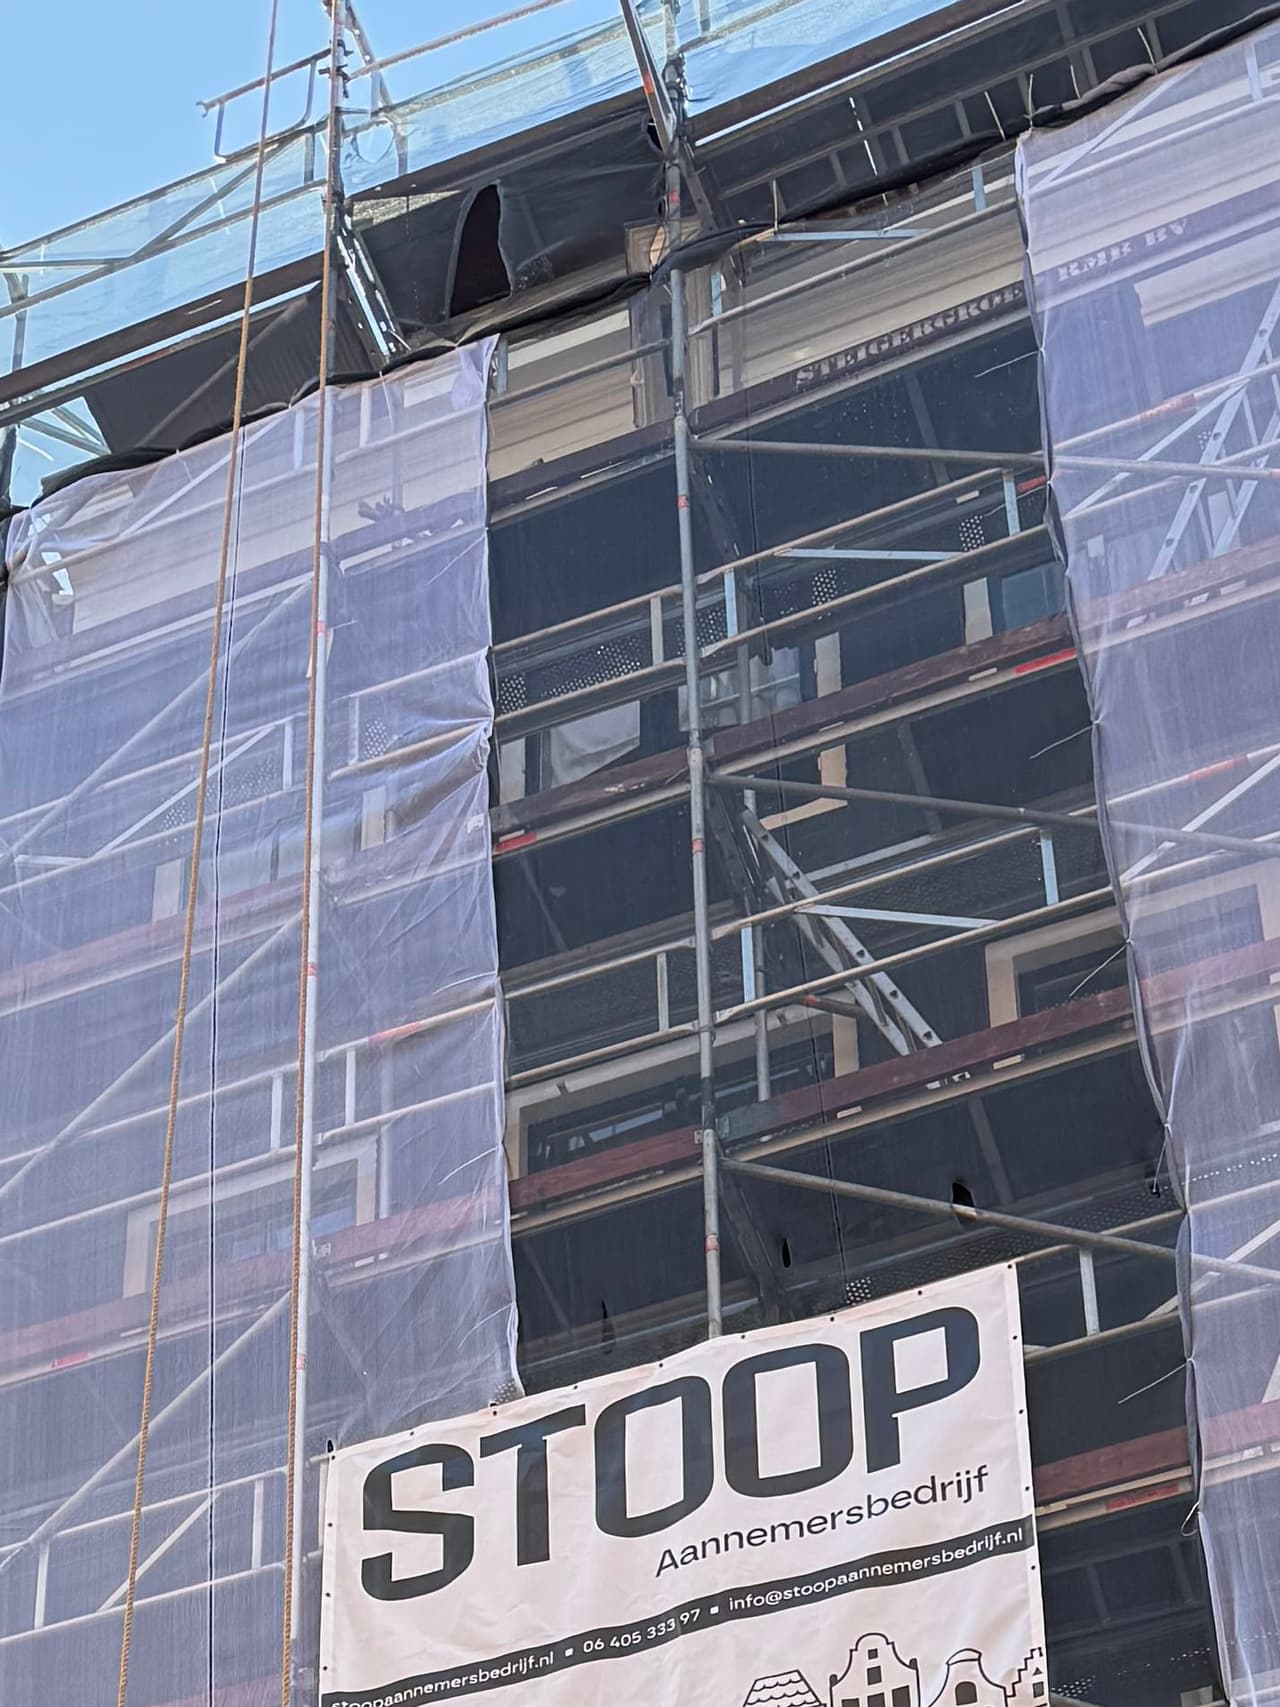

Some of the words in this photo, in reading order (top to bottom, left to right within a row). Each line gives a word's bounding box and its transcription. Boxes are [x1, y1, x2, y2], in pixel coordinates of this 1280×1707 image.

[361, 1305, 981, 1601] STOOP
[655, 1465, 988, 1577] Aannemersbedrijf
[583, 1638, 606, 1654] 06
[610, 1631, 643, 1649] 405
[646, 1618, 677, 1640] 333
[680, 1608, 702, 1626] 97
[728, 1527, 1024, 1612] info@stoopaannemersbedrijf.nl
